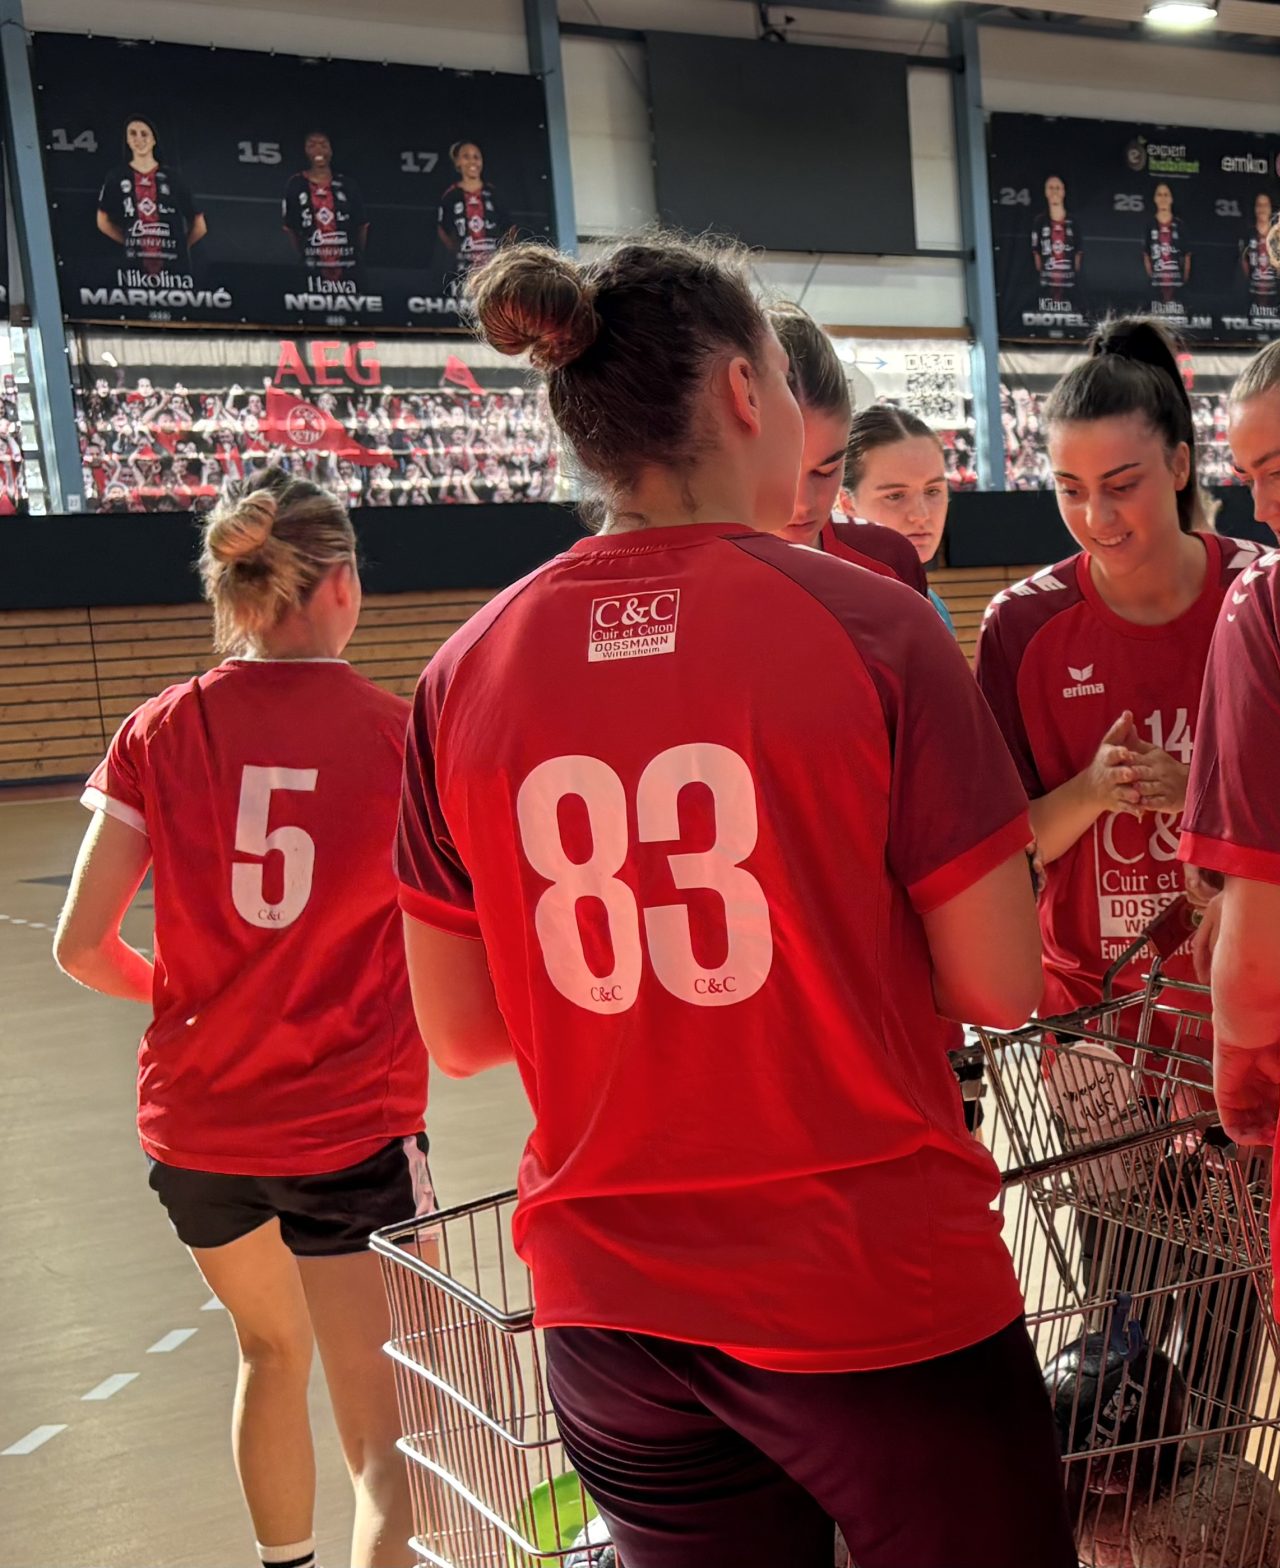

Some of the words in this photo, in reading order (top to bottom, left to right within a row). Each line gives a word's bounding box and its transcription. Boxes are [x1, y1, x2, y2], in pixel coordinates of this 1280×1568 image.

[52, 128, 98, 152] 14
[238, 141, 282, 165] 15
[401, 151, 439, 173] 17
[1000, 188, 1031, 206] 24
[1215, 199, 1242, 217] 31
[117, 269, 194, 288] Nikolina
[308, 276, 357, 294] Hawa
[80, 287, 232, 308] MARKOVIĆ
[284, 294, 383, 313] N'DIAYE
[274, 340, 382, 386] AEG
[595, 594, 675, 628] C&C
[592, 629, 619, 642] Cuir
[622, 629, 633, 638] et
[638, 623, 674, 636] Coton
[595, 635, 668, 653] DOSSMANN
[1062, 682, 1105, 699] erima
[1144, 708, 1194, 764] 14
[231, 764, 319, 930] 5
[1103, 811, 1181, 864] C&
[517, 742, 773, 1015] 83
[1102, 869, 1149, 892] Cuir
[1157, 870, 1179, 889] et
[258, 909, 285, 921] C&C
[590, 985, 624, 1002] C&C
[694, 977, 737, 994] C&C
